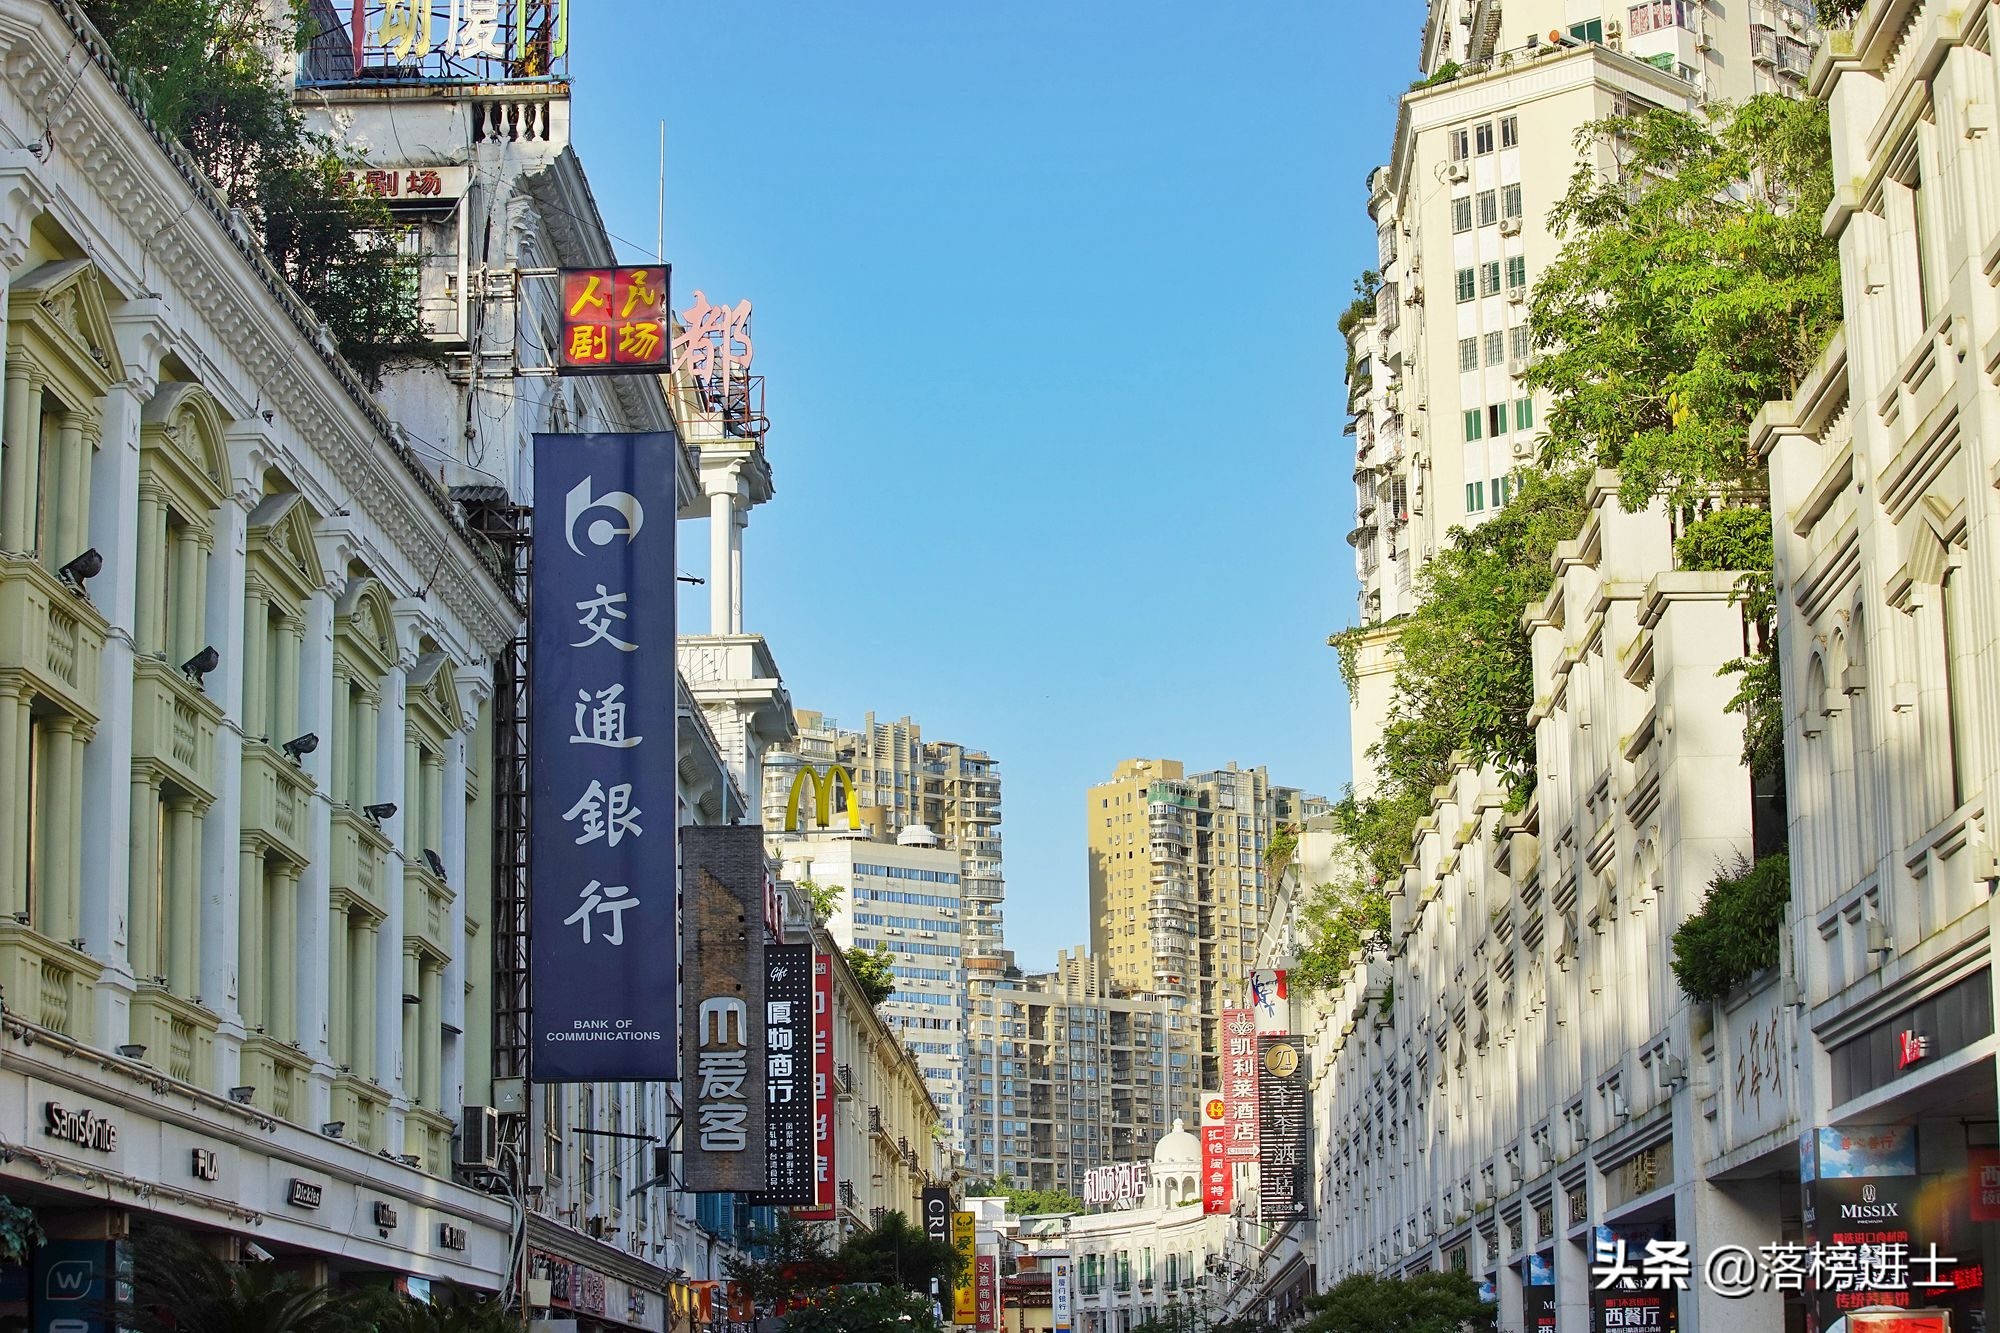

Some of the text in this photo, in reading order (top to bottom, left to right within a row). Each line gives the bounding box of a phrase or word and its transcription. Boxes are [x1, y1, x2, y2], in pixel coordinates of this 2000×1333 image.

[569, 270, 655, 319] 人民
[570, 321, 660, 360] 剧场
[562, 584, 644, 946] 交通銀行
[770, 966, 789, 982] Gift
[546, 1030, 661, 1041] COMMUNICATIONS
[573, 1020, 633, 1029] BANK OF
[1230, 1037, 1255, 1141] 凯利莱酒店
[46, 1101, 118, 1152] Samsonite
[1272, 1086, 1295, 1196] 全季酒店
[192, 1148, 220, 1181] FILA
[294, 1183, 320, 1204] Dickies
[978, 1262, 991, 1324] 达意商业城
[1058, 1278, 1066, 1311] 厦门银行
[1605, 1306, 1660, 1327] 西餐厅
